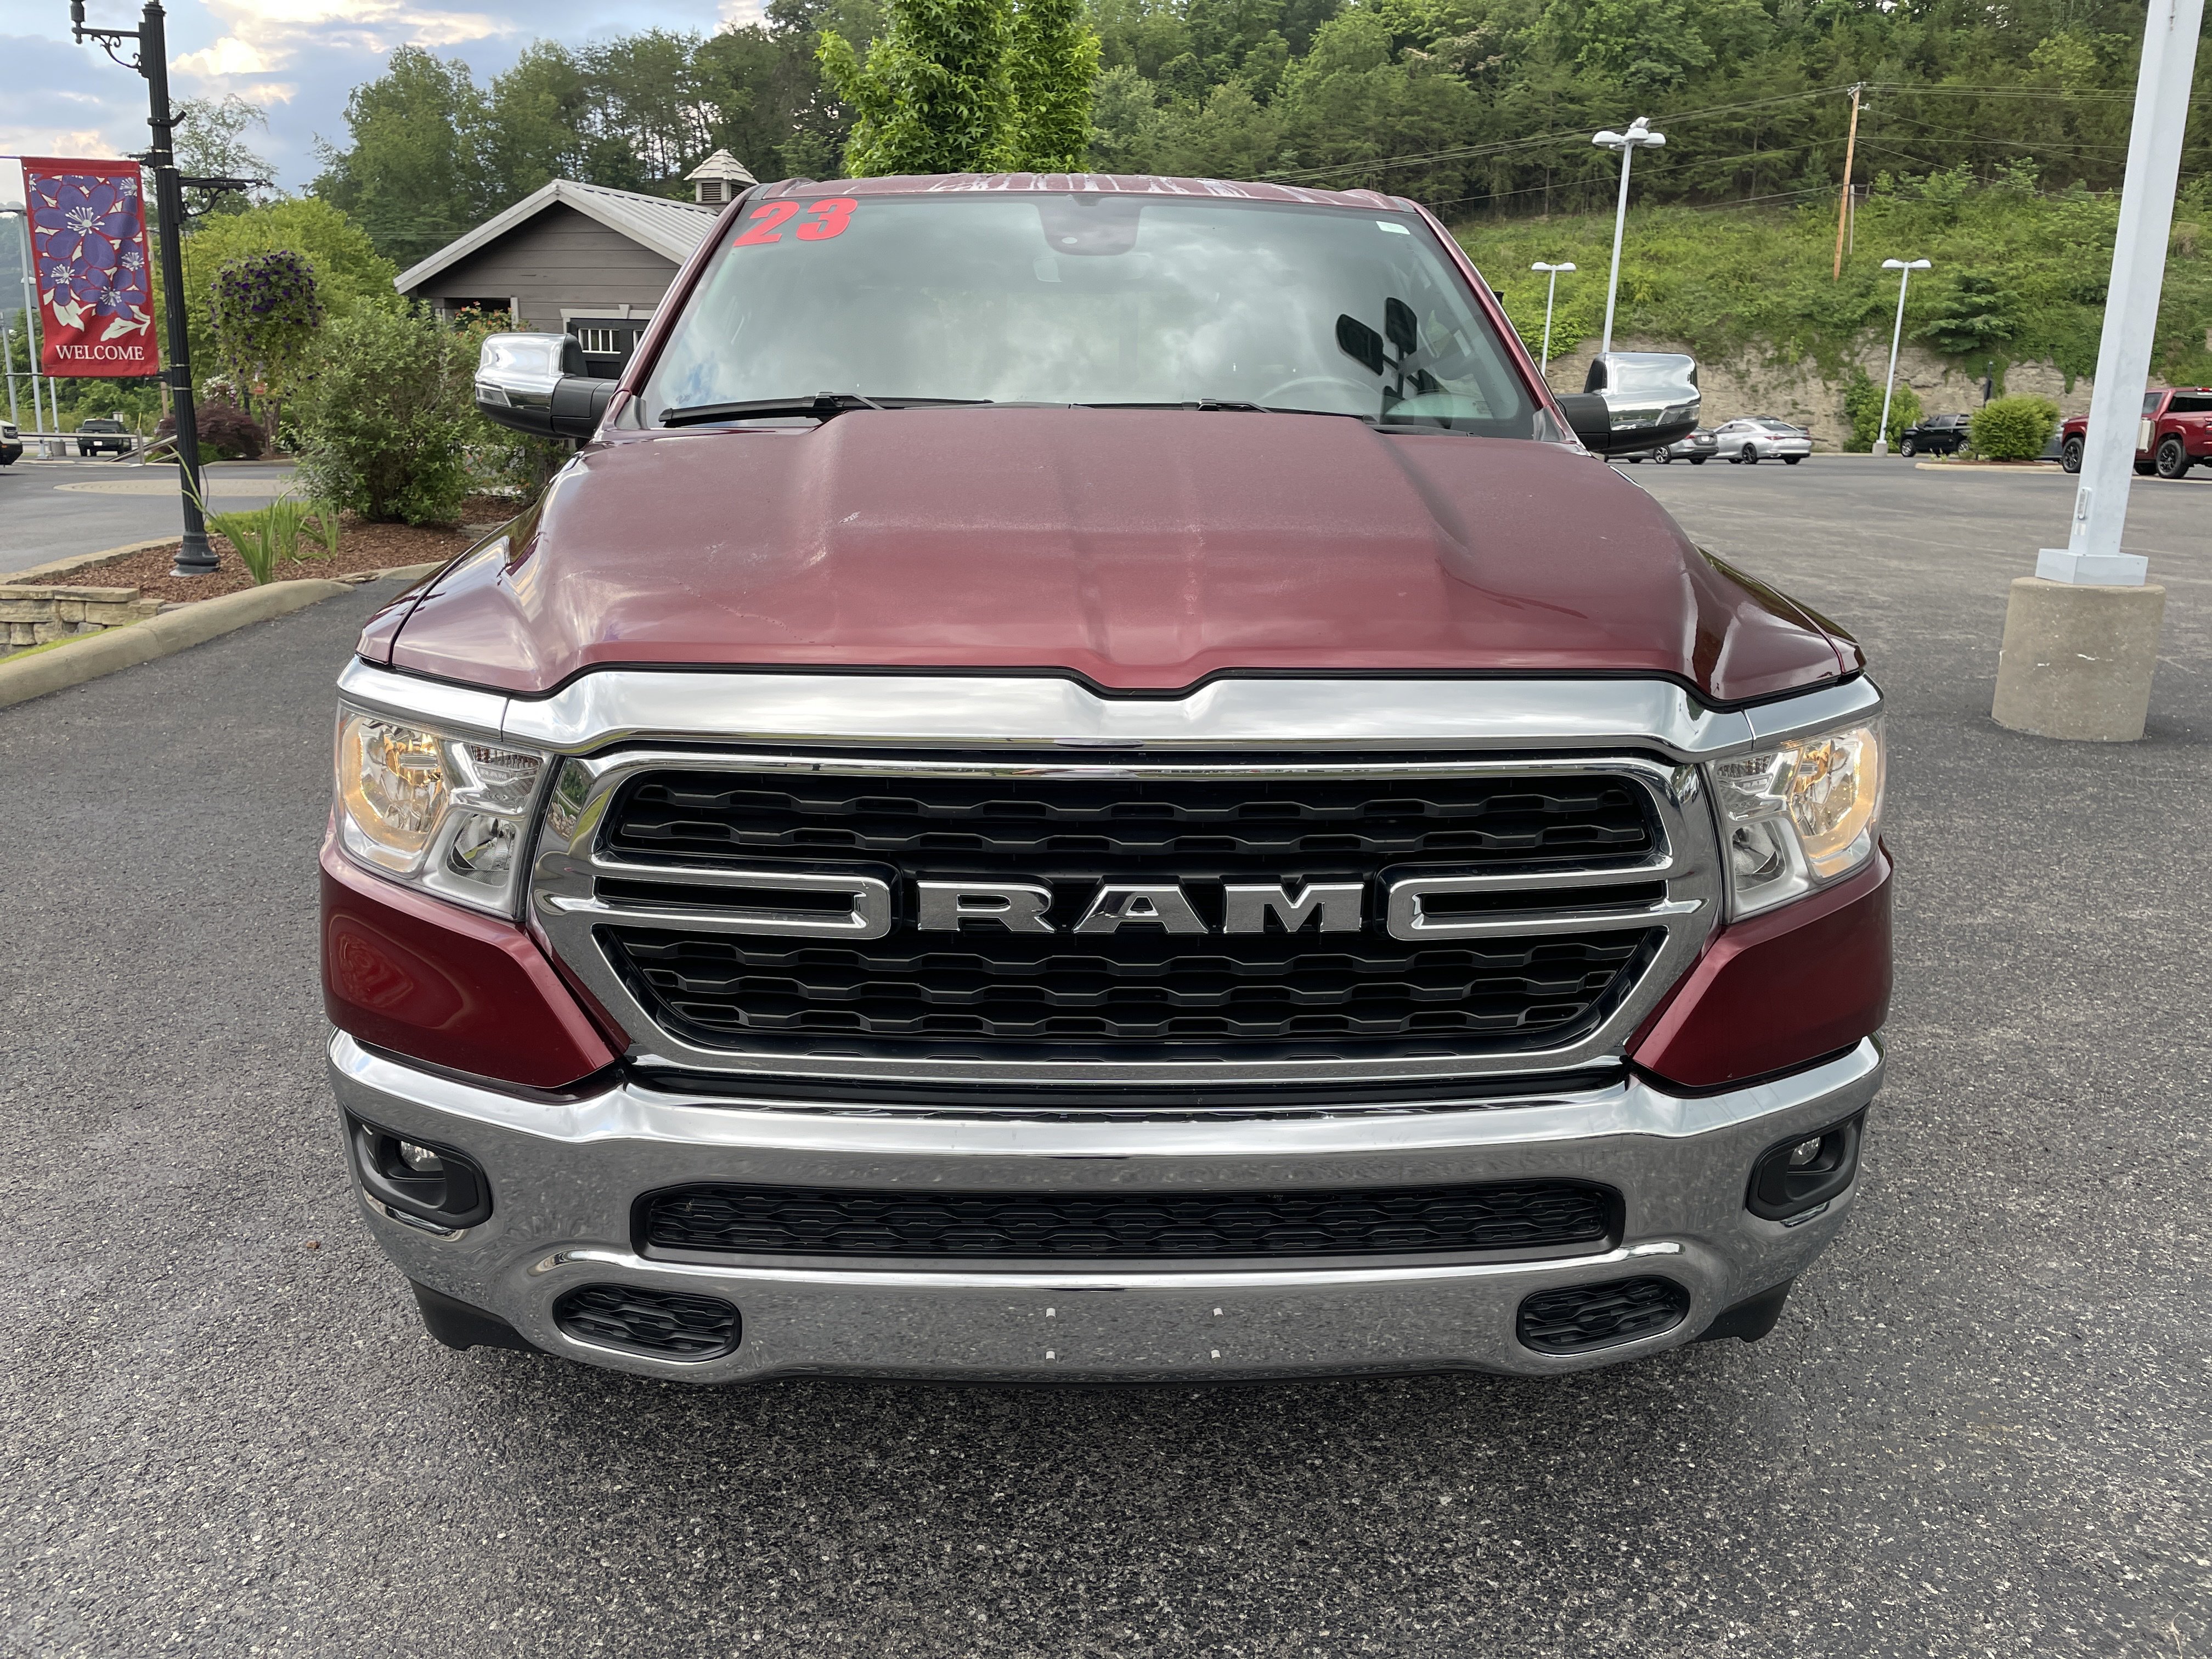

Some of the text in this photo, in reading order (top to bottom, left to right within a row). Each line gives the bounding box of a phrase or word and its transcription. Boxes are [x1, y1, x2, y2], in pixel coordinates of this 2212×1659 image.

[732, 198, 858, 247] 23
[55, 345, 145, 360] WELCOME
[917, 881, 1365, 934] RAM
